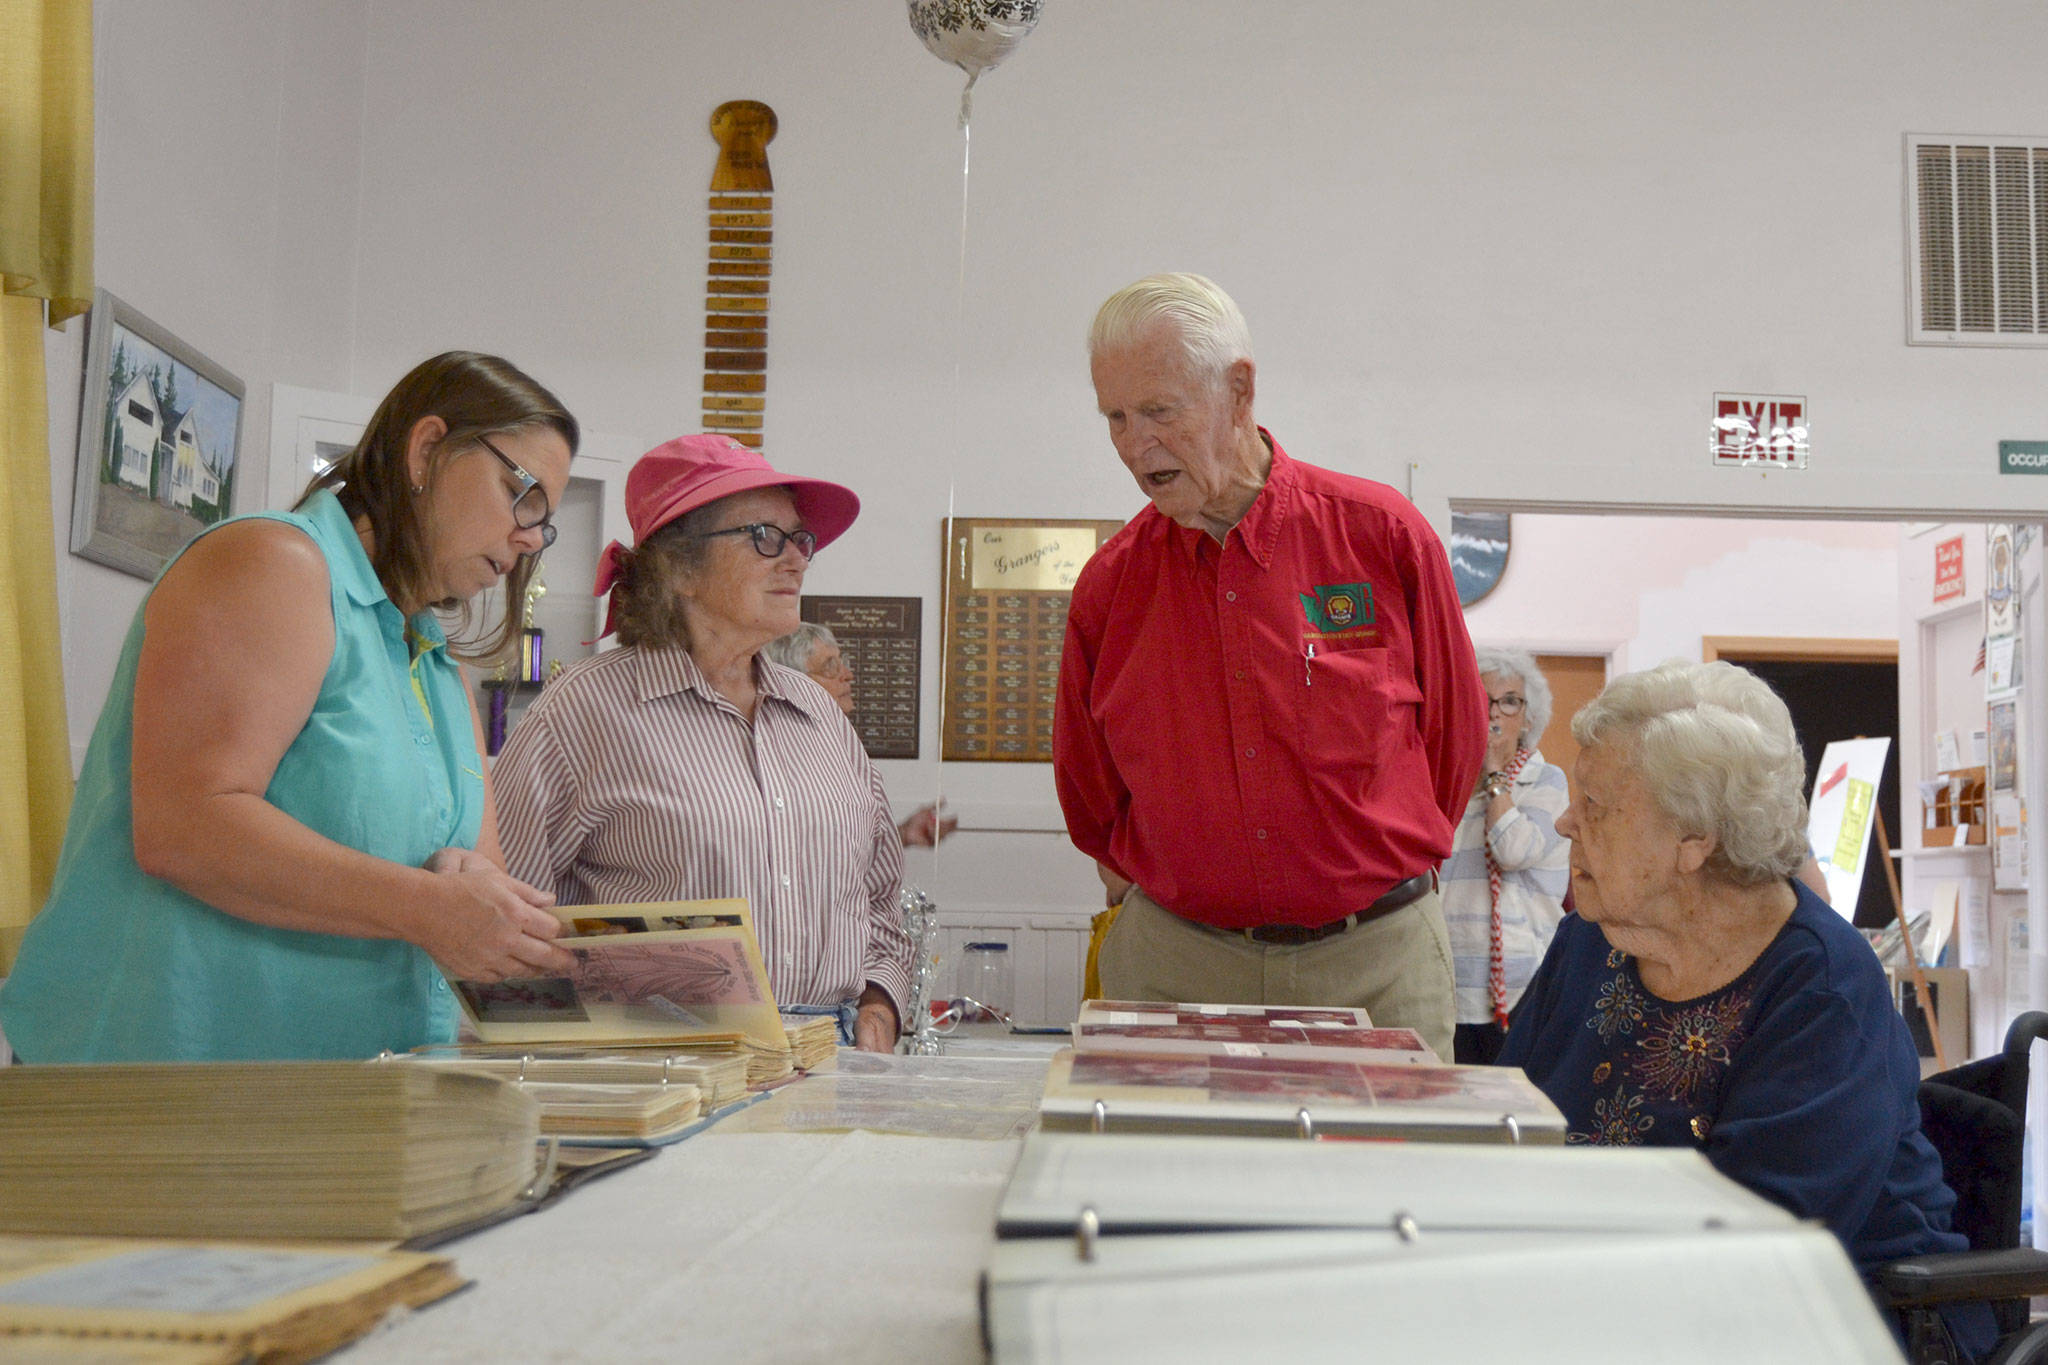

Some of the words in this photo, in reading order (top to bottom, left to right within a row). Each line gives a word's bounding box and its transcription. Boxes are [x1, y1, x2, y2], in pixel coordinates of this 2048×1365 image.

[729, 246, 753, 257] 1975
[1718, 400, 1802, 461] EXIT
[993, 542, 1060, 574] Grangers
